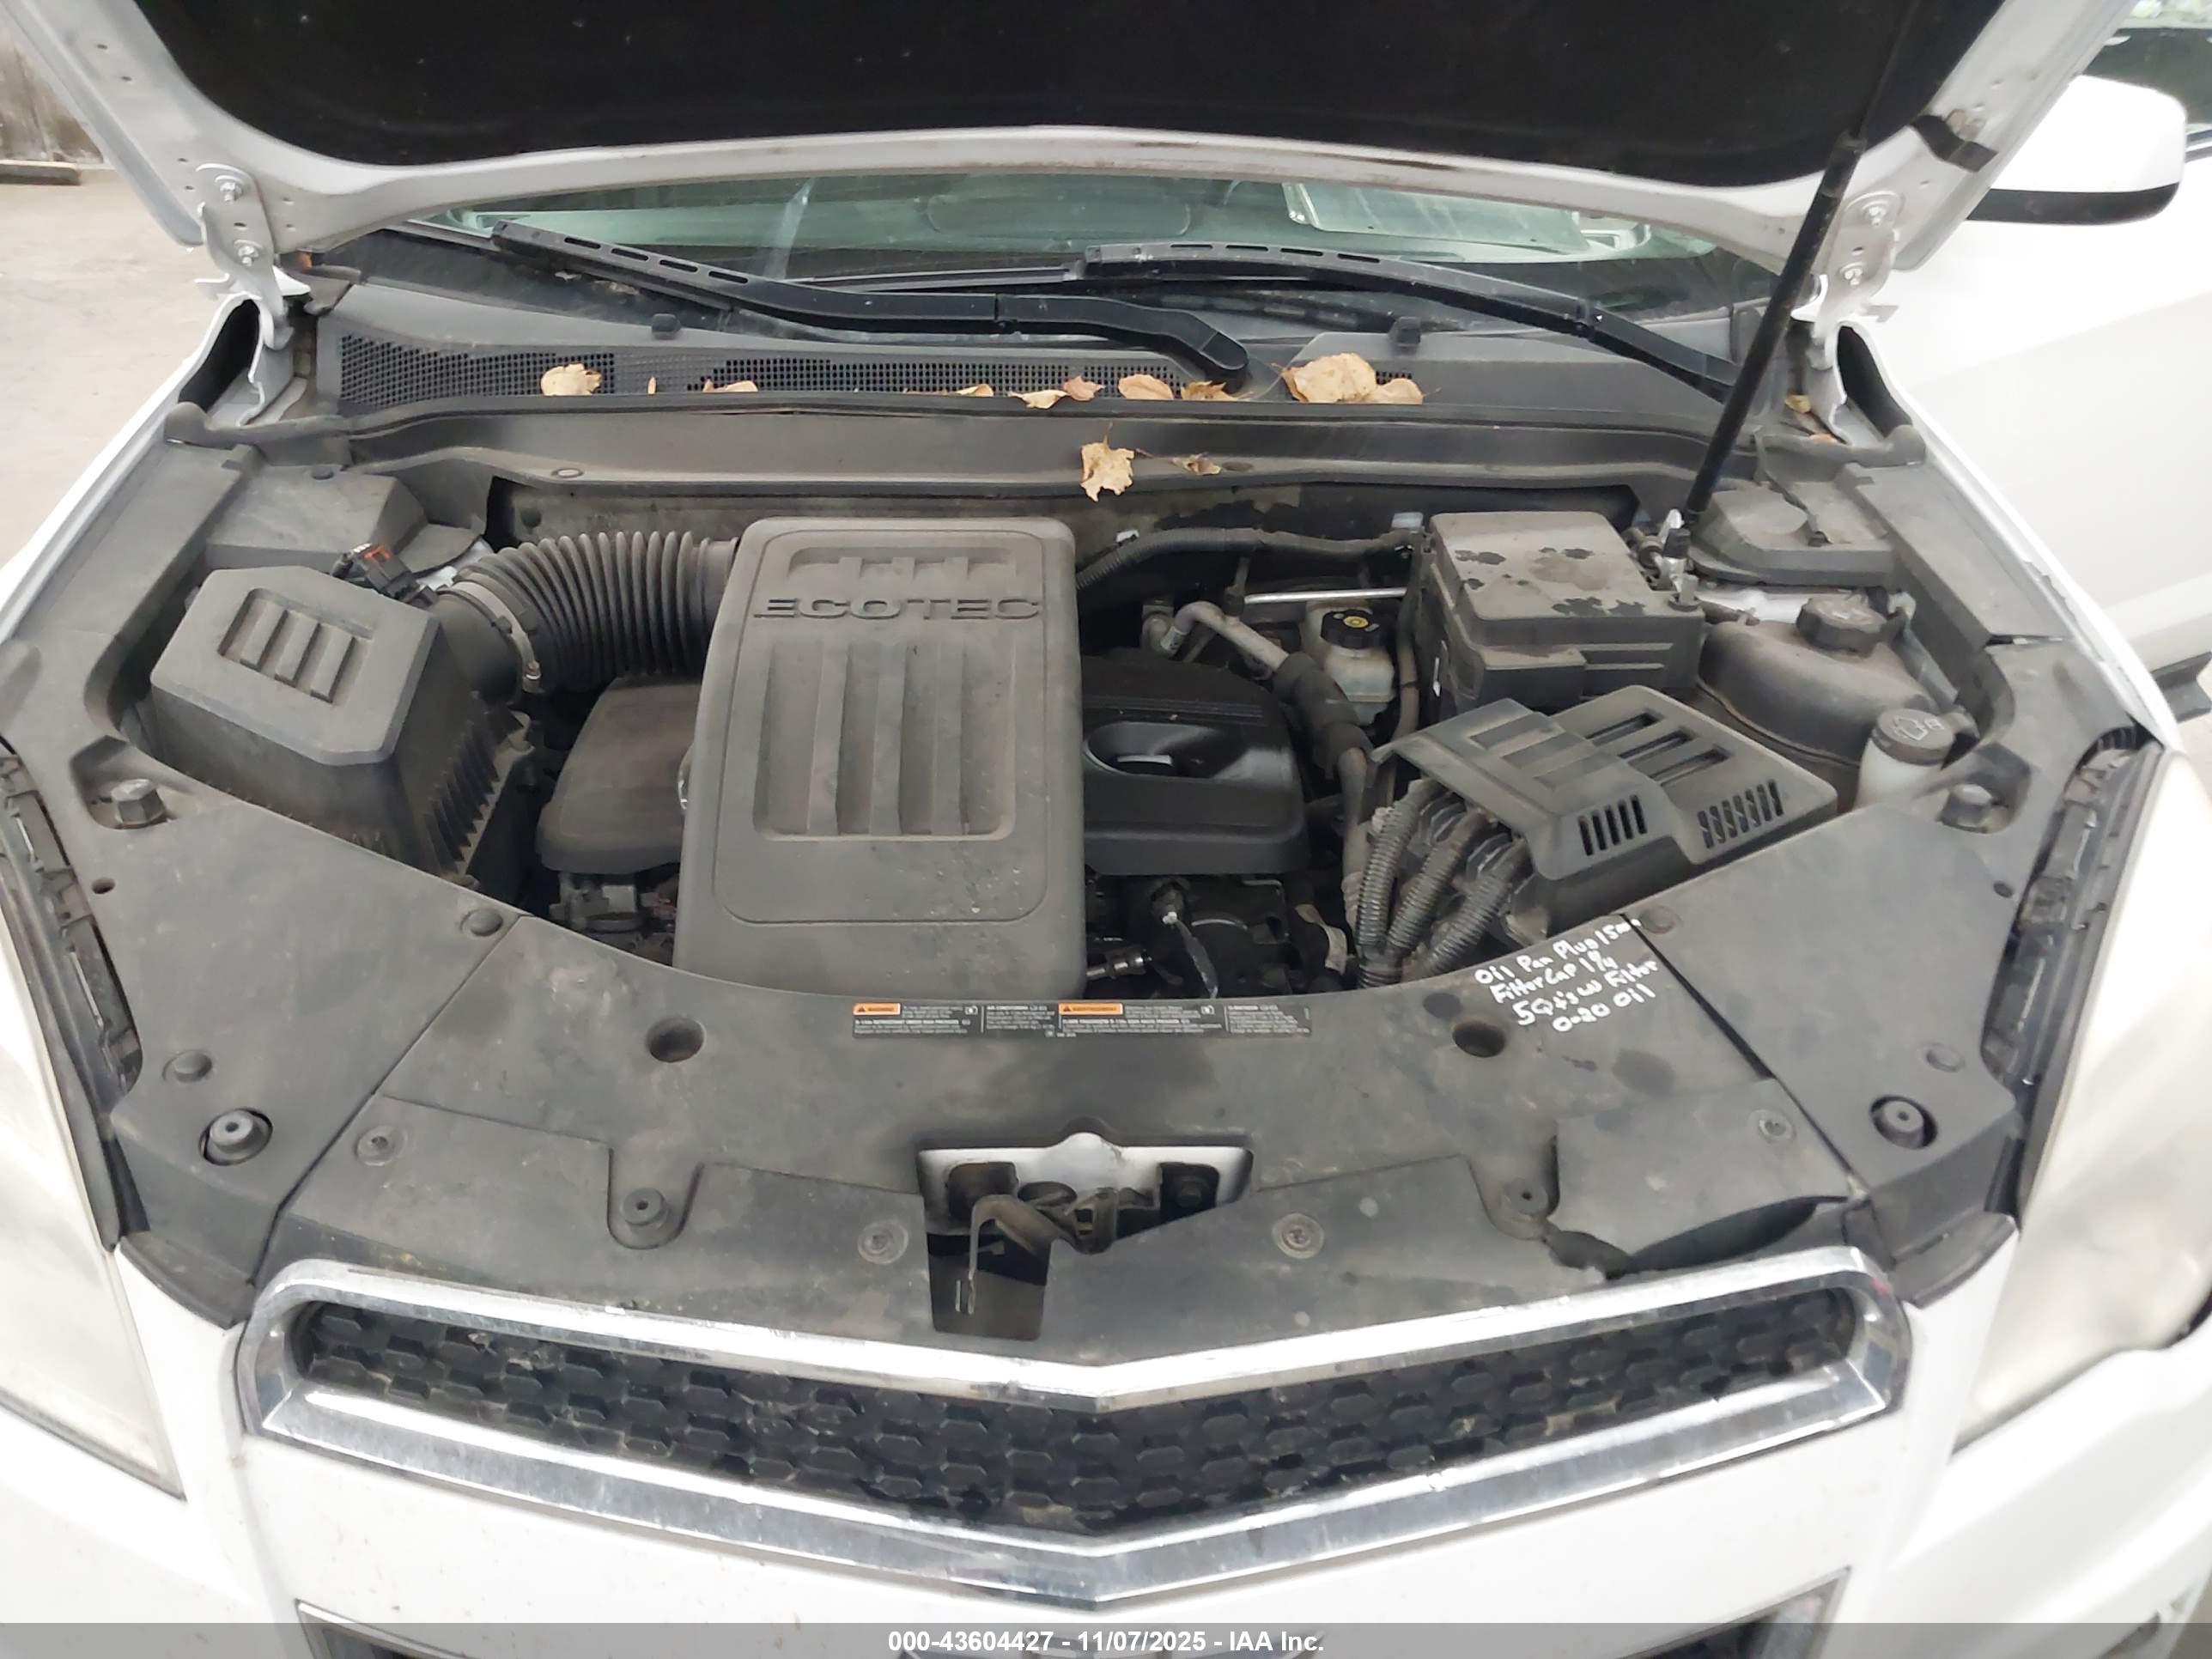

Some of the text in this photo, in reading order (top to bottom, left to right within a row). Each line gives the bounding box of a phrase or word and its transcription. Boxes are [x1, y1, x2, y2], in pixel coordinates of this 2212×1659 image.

[753, 599, 1039, 620] ECOTEC
[1475, 965, 1516, 984] Oil
[1516, 955, 1553, 972] Pan
[1613, 982, 1656, 1007] Oil
